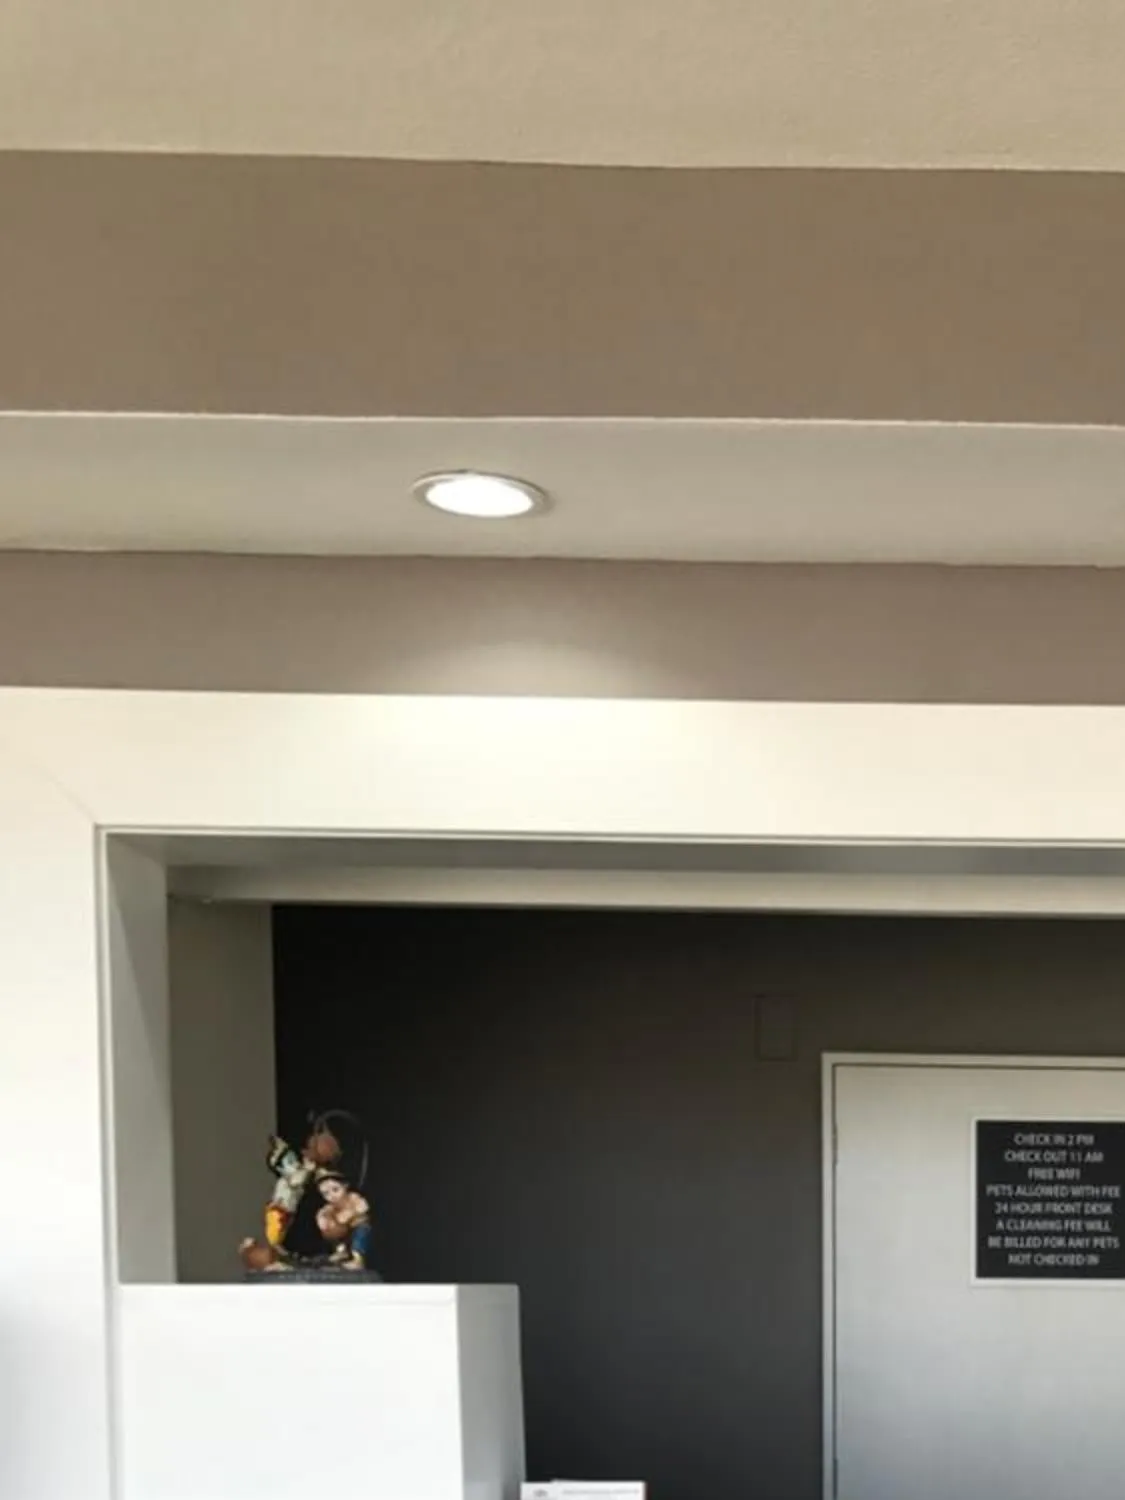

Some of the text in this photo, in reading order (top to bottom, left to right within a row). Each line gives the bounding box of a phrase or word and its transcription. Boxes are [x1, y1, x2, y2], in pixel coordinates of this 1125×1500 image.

[1013, 1133, 1051, 1146] CHECK
[1075, 1133, 1095, 1146] PM
[1004, 1149, 1104, 1162] CHECK OUT 11 AM
[1028, 1167, 1054, 1180] FREE
[986, 1184, 1120, 1198] PETS ALLOWED WITH FEE
[994, 1201, 1113, 1214] 24 HOUR FRONT DESK
[1006, 1218, 1062, 1231] CLEANING
[1064, 1218, 1083, 1231] FEE
[1084, 1218, 1112, 1231] WILL
[988, 1235, 1120, 1248] BE BILLED FOR ANY PETS
[1008, 1252, 1100, 1265] NOT CHECKED IN
